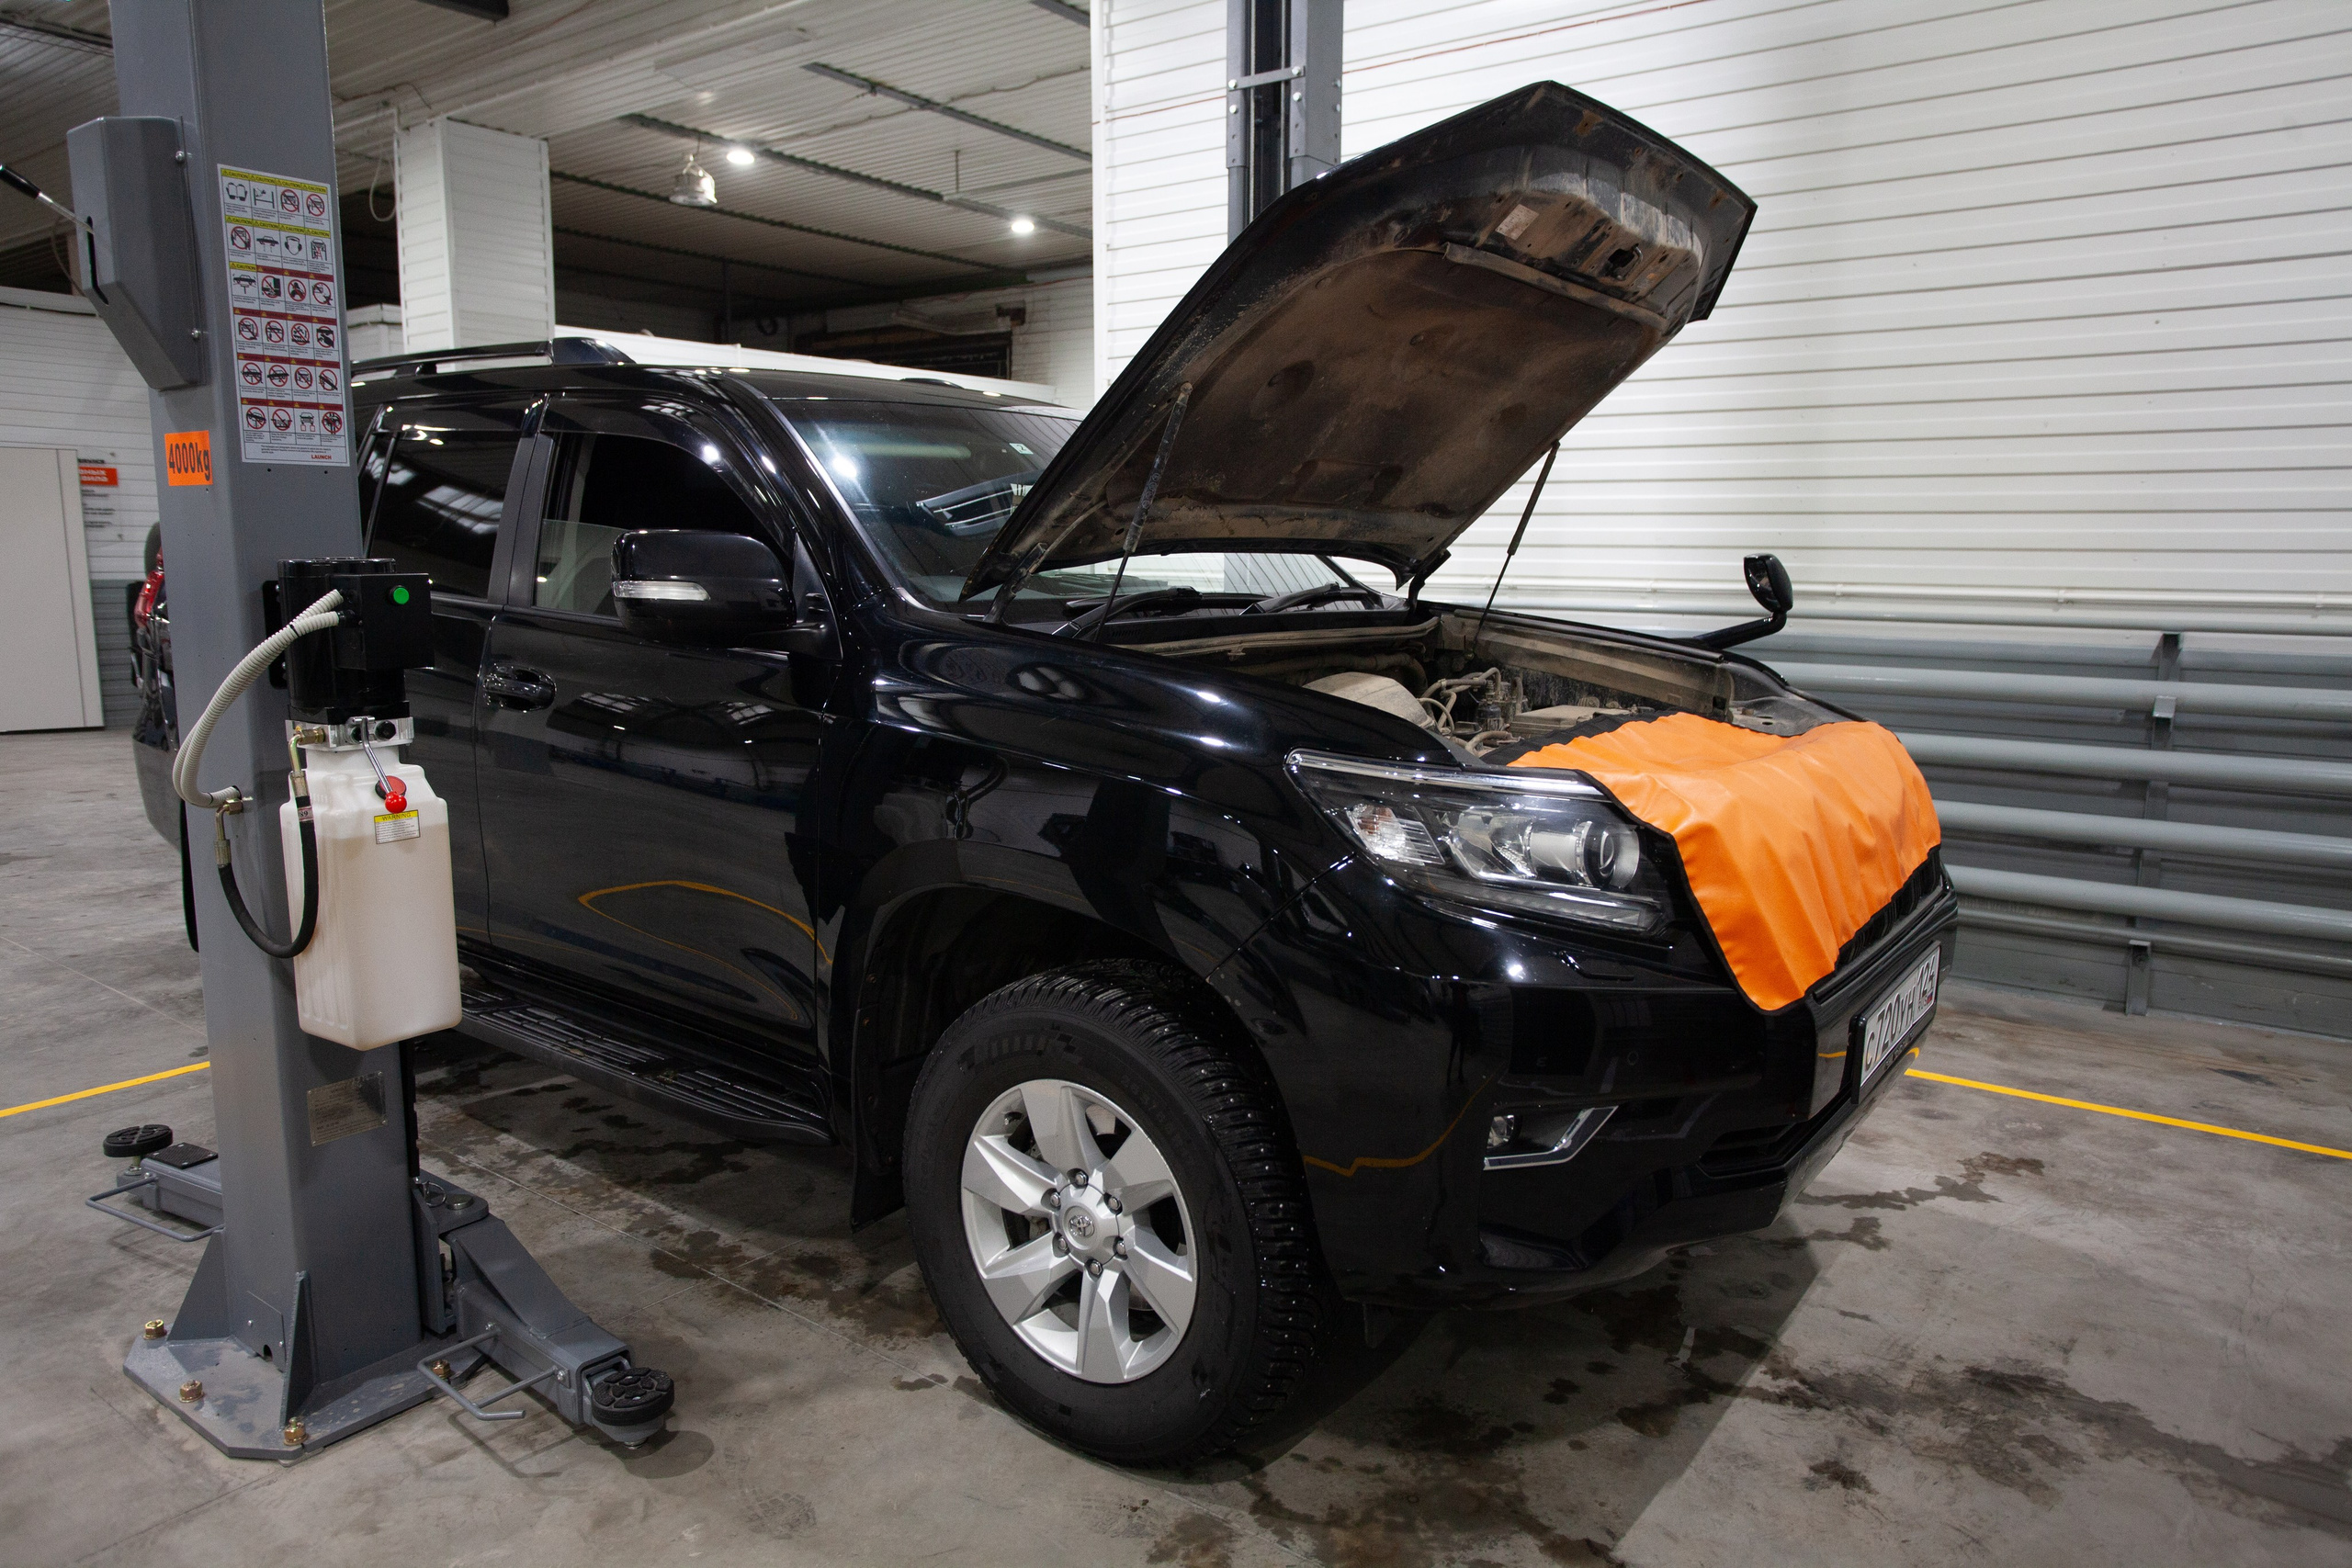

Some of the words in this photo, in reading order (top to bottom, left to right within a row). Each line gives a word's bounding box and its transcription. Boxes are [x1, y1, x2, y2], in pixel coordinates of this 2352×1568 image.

[228, 171, 249, 179] CAUTION
[281, 180, 301, 188] CAUTION
[285, 225, 305, 233] CAUTION
[311, 229, 330, 237] CAUTION
[168, 442, 211, 481] 4000kg
[382, 813, 412, 821] WARNING
[1917, 954, 1935, 1001] 124
